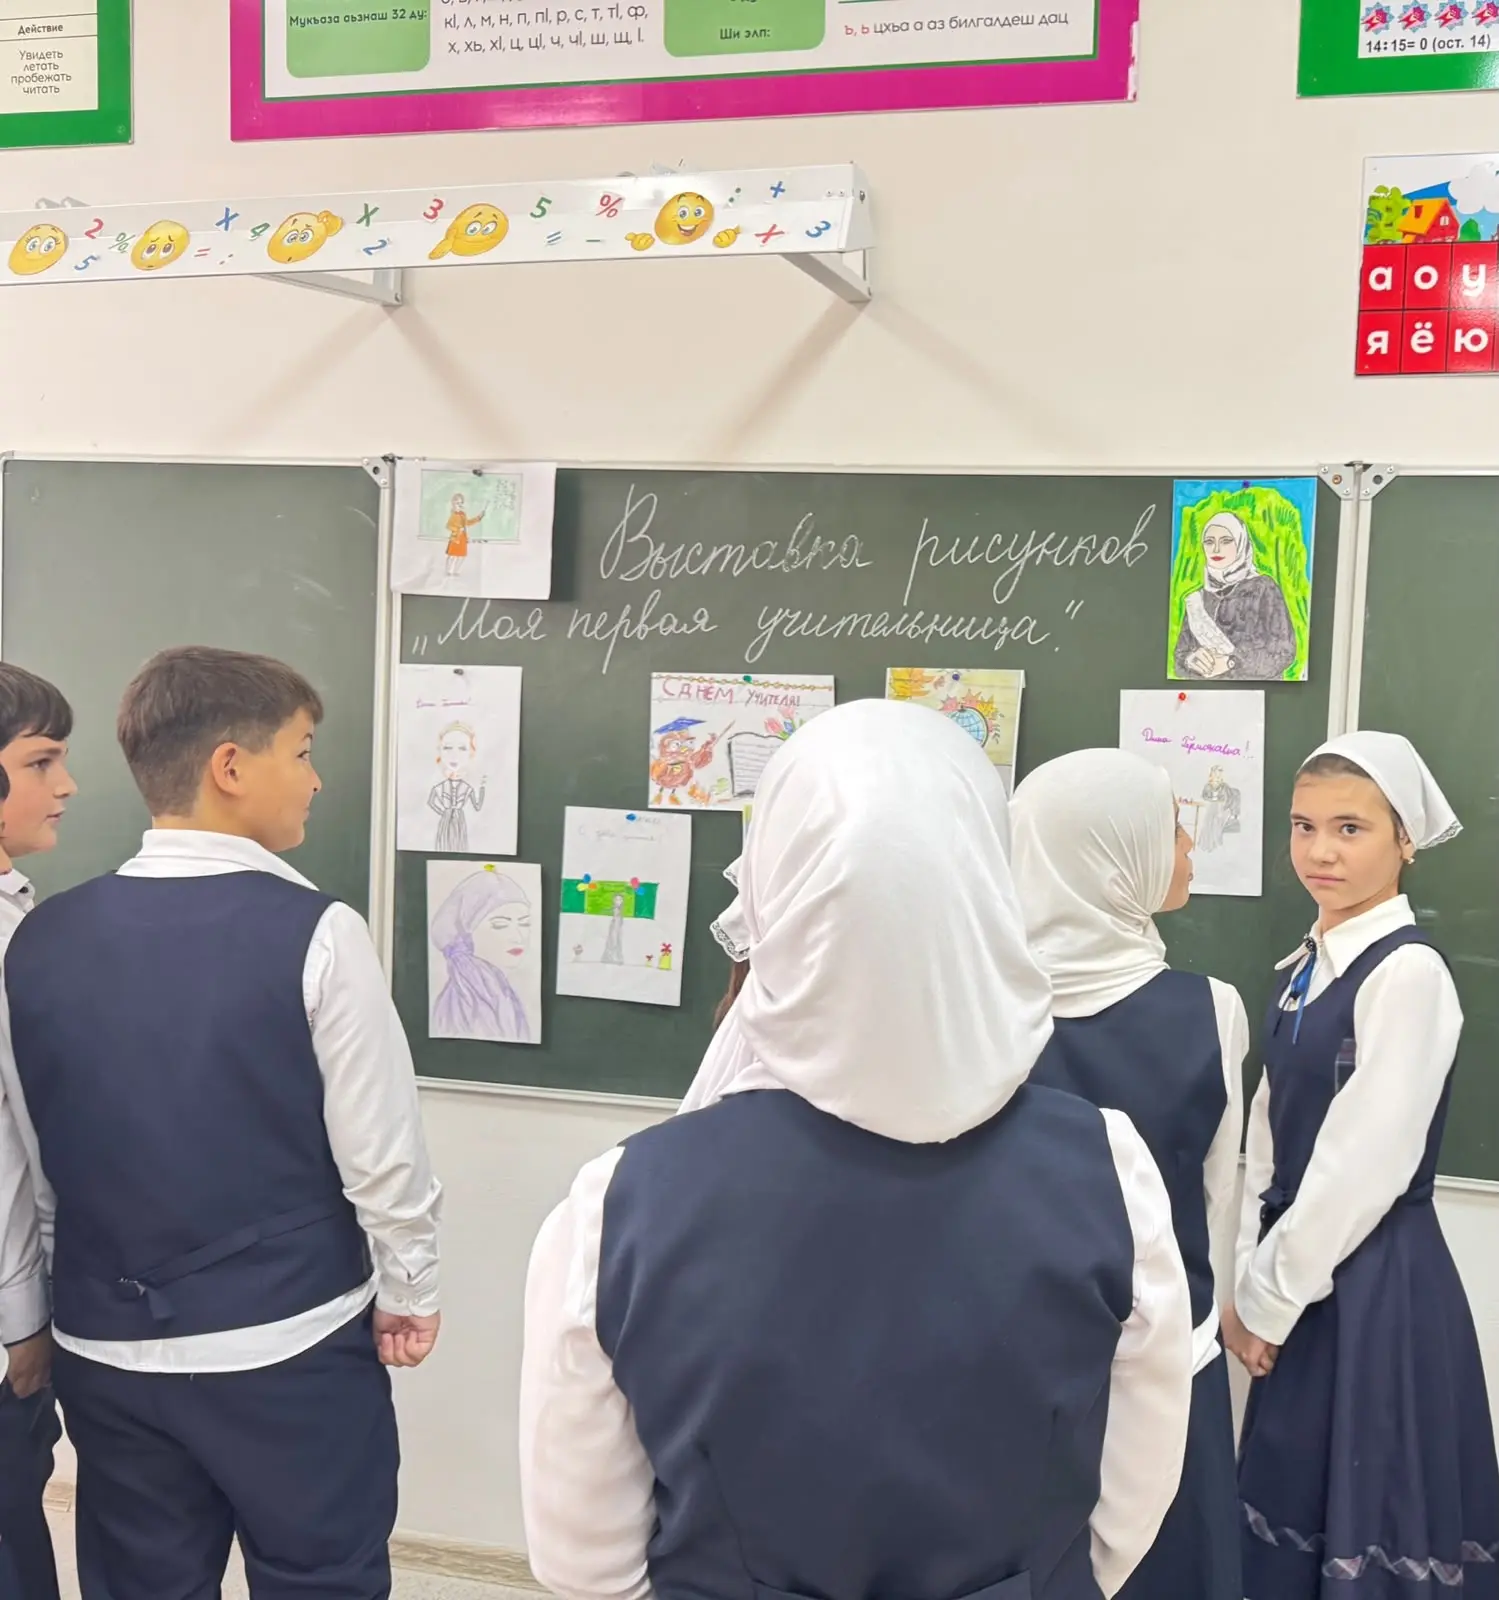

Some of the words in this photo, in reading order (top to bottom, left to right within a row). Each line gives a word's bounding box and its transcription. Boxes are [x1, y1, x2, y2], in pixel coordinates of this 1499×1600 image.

[344, 11, 388, 23] аьзнаш
[391, 8, 407, 20] 32
[409, 9, 428, 21] ду:
[464, 17, 477, 30] л,
[481, 15, 495, 28] м,
[500, 14, 513, 27] н,
[518, 12, 531, 26] п,
[557, 10, 571, 25] р,
[574, 8, 588, 23] с,
[590, 8, 603, 21] т,
[627, 5, 649, 20] ф,
[913, 20, 924, 32] а
[927, 19, 945, 31] аз
[949, 14, 1035, 30] билгалдеш
[1038, 12, 1069, 27] дац
[17, 24, 64, 36] Действие
[720, 28, 741, 40] Ши
[448, 41, 461, 55] х,
[464, 40, 486, 54] хь,
[510, 37, 524, 51] ц,
[550, 36, 564, 49] ч,
[591, 33, 610, 46] ш,
[1420, 37, 1428, 51] 0
[1432, 36, 1465, 53] (ост.
[1470, 33, 1491, 50] 14)
[19, 50, 64, 60] Увидеть
[23, 62, 60, 72] летать
[10, 73, 73, 85] пробежать
[22, 85, 61, 95] читать
[1368, 266, 1393, 291] а
[1413, 265, 1438, 290] о
[1462, 263, 1486, 297] у
[1366, 330, 1389, 355] я
[1410, 321, 1434, 354] ё
[1454, 328, 1488, 353] ю
[600, 483, 873, 581] Выставка
[903, 504, 1156, 605] рисунков
[568, 589, 718, 674] первая
